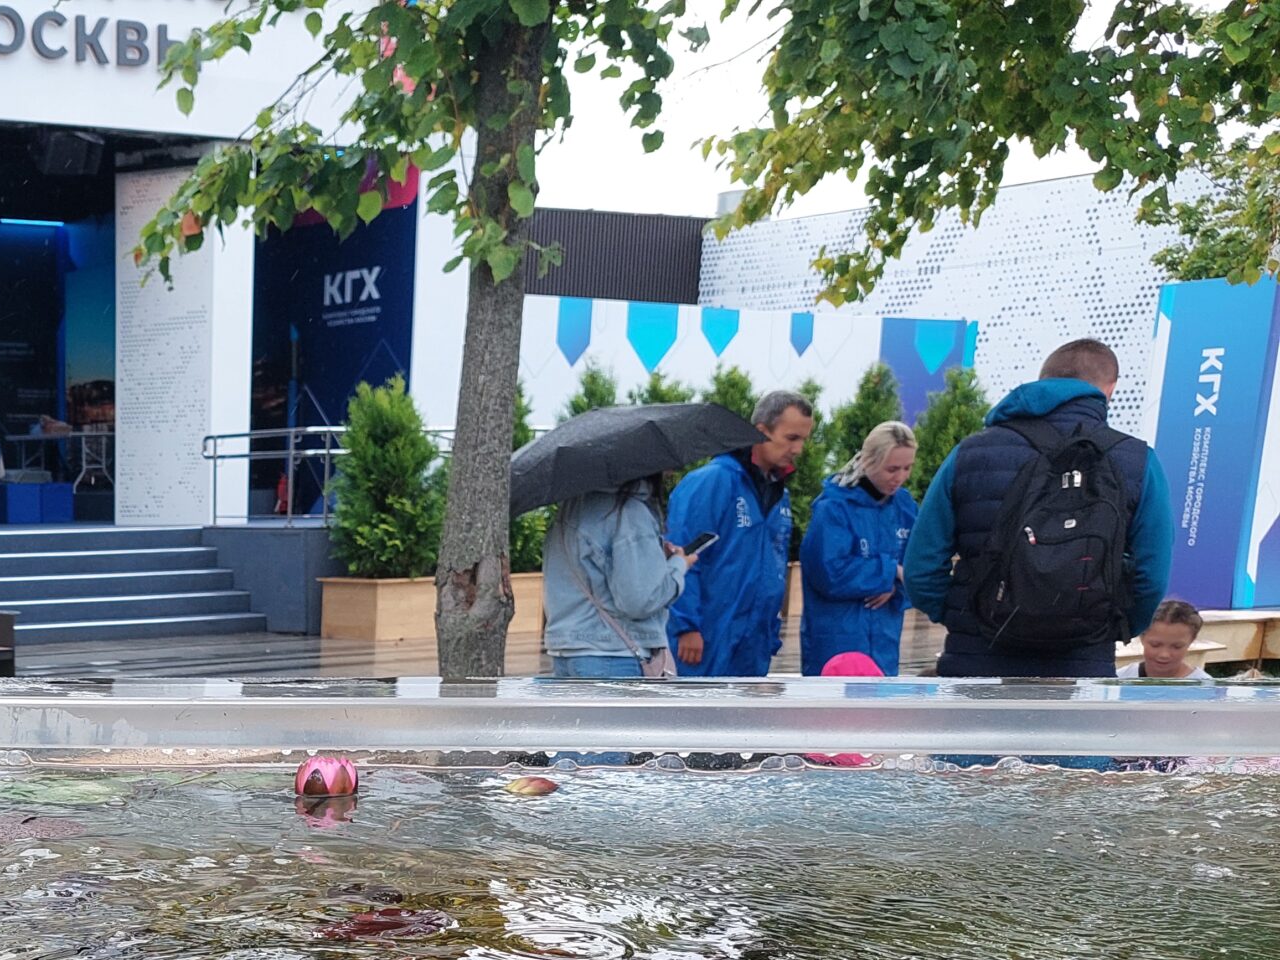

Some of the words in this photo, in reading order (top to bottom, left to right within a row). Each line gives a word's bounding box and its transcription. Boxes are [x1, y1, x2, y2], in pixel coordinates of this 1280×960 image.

[323, 265, 381, 306] КГХ
[1194, 347, 1225, 417] КГХ
[1188, 427, 1202, 484] ХОЗЯЙСТВА
[1197, 426, 1212, 481] КОМПЛЕКС
[1181, 486, 1194, 529] МОСКВЫ
[1187, 482, 1205, 547] ГОРОДСКОГО
